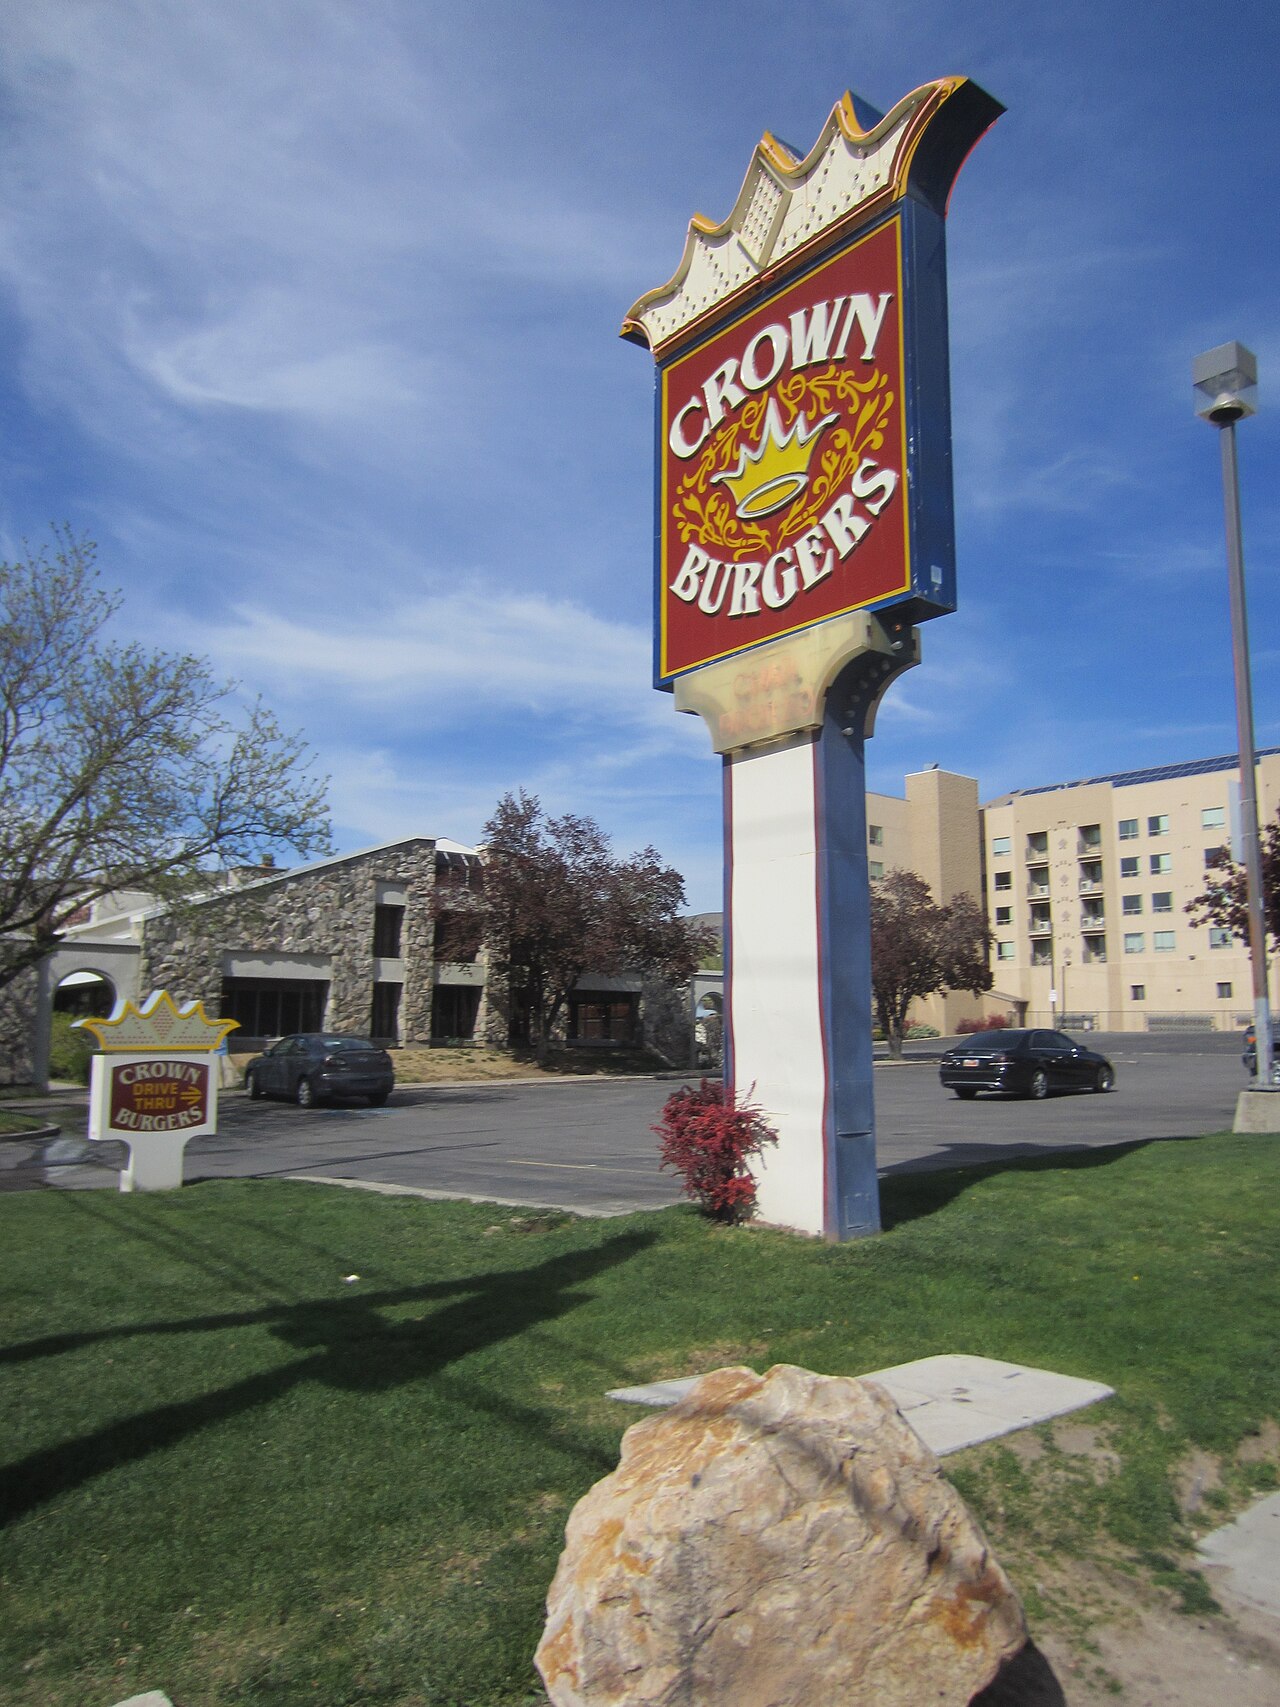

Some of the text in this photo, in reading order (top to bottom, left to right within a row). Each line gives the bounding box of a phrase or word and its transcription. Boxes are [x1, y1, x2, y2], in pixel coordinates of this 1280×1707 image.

[669, 293, 894, 458] CROWN
[669, 458, 898, 617] BURGERS
[120, 1062, 201, 1084] CROWN
[133, 1082, 179, 1096] DRIVE
[135, 1096, 176, 1110] THRU
[116, 1106, 202, 1130] BURGERS
